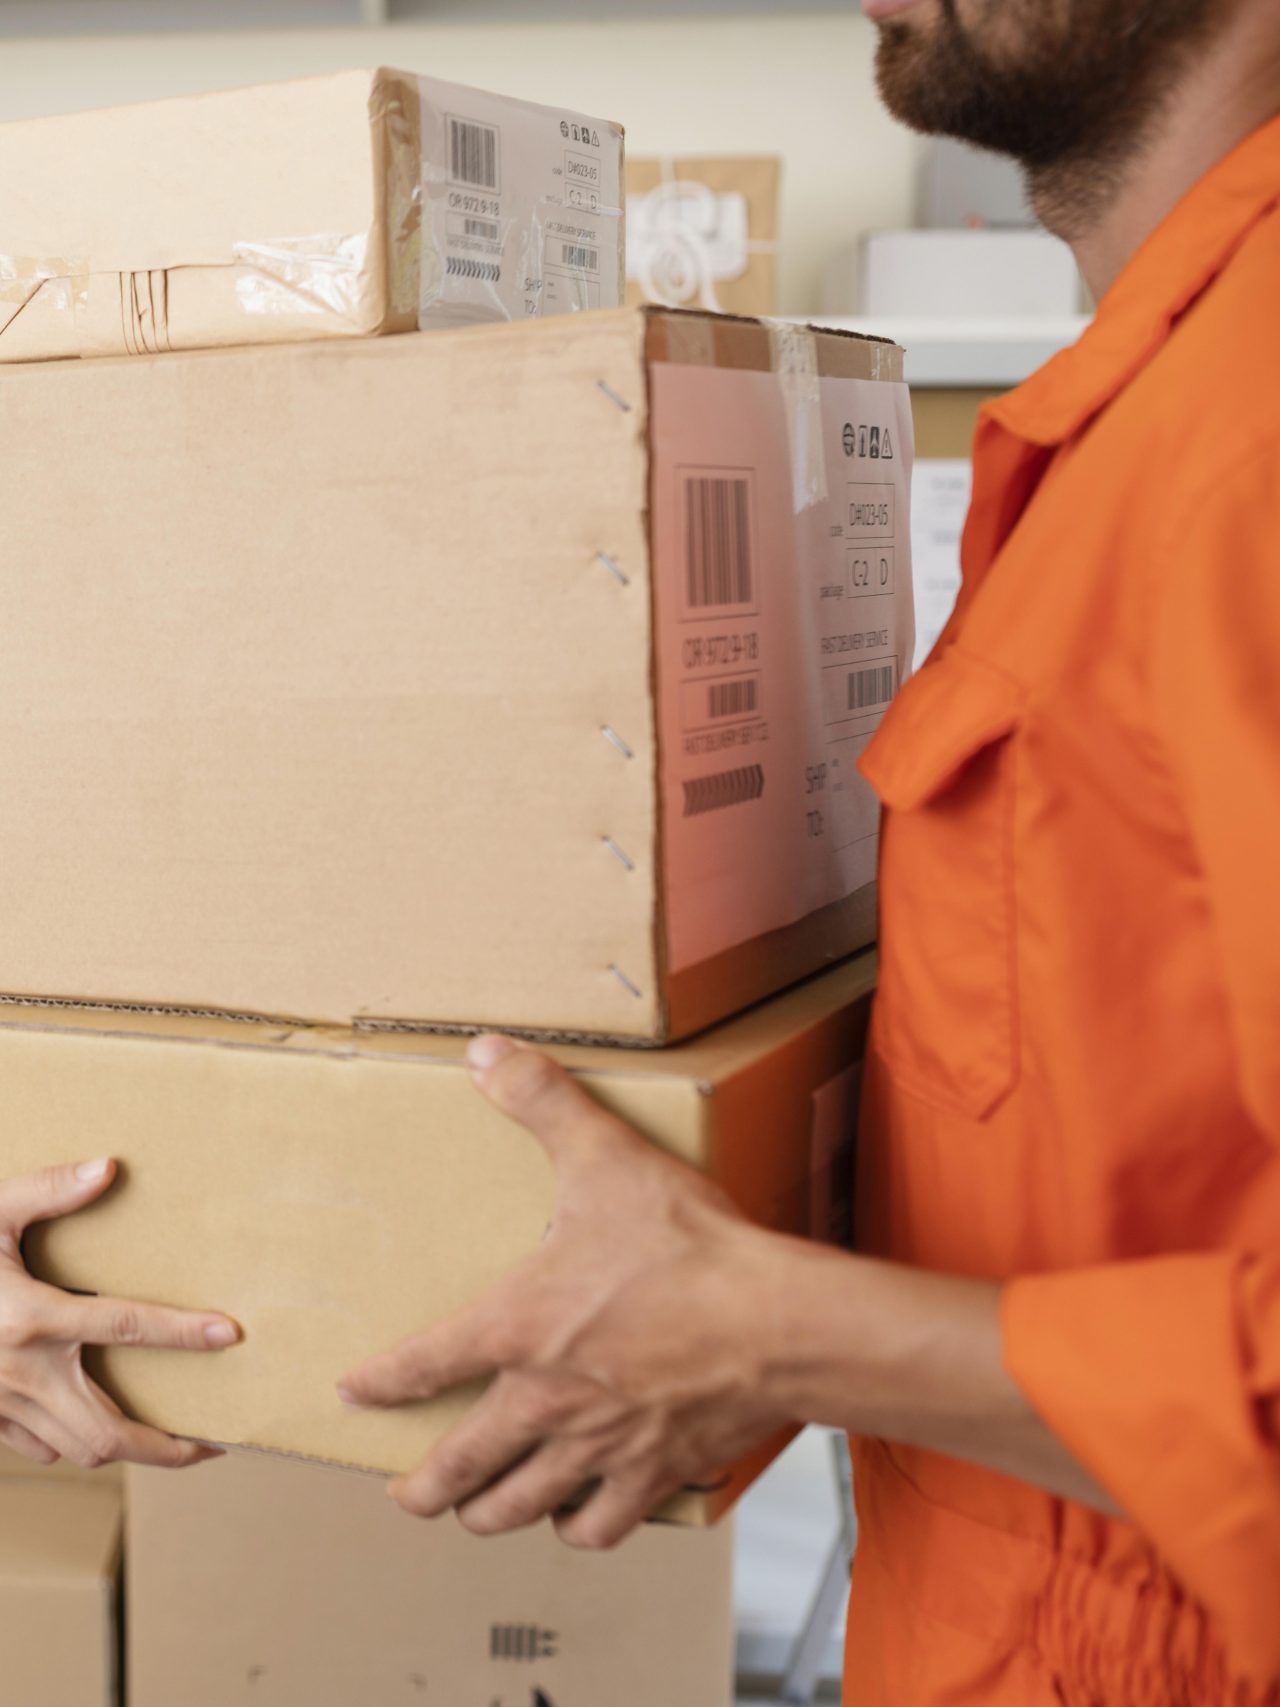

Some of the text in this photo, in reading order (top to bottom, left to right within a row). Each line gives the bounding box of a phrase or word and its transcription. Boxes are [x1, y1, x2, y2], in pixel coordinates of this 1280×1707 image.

[849, 502, 889, 527] D#023-05
[852, 559, 869, 587] C-2
[880, 558, 889, 586] D
